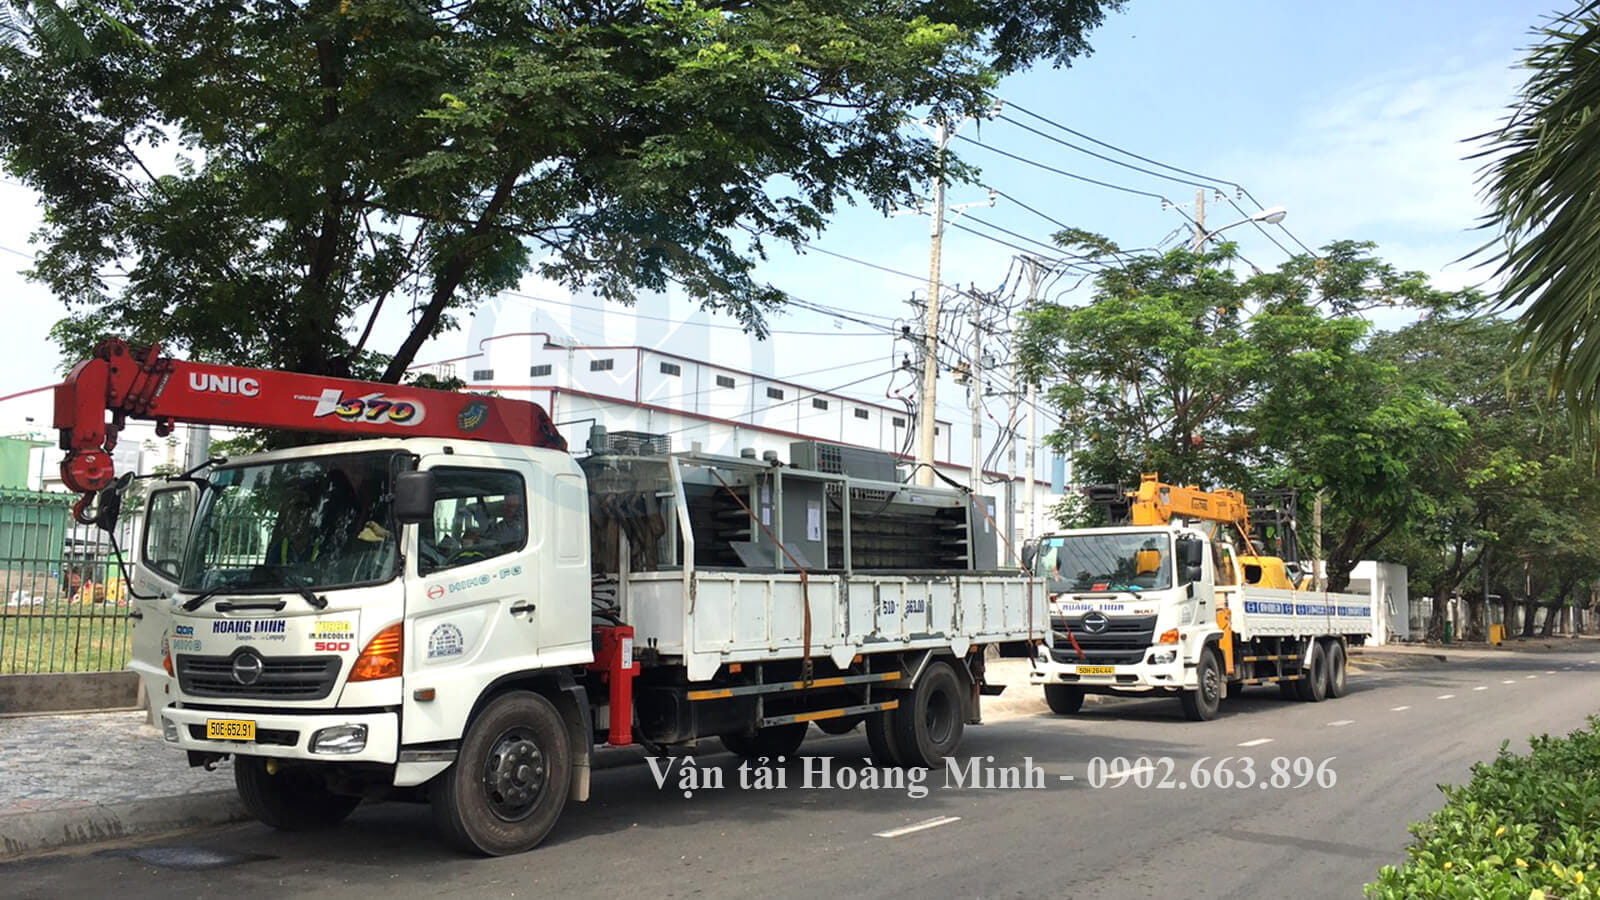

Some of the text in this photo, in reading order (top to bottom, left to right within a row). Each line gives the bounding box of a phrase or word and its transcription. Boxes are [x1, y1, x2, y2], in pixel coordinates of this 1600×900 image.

[188, 372, 260, 397] UNIC
[212, 620, 287, 634] HOANG MINH
[308, 632, 355, 640] INERCOOLER
[314, 641, 351, 652] 500
[210, 721, 251, 737] 50E-652.91
